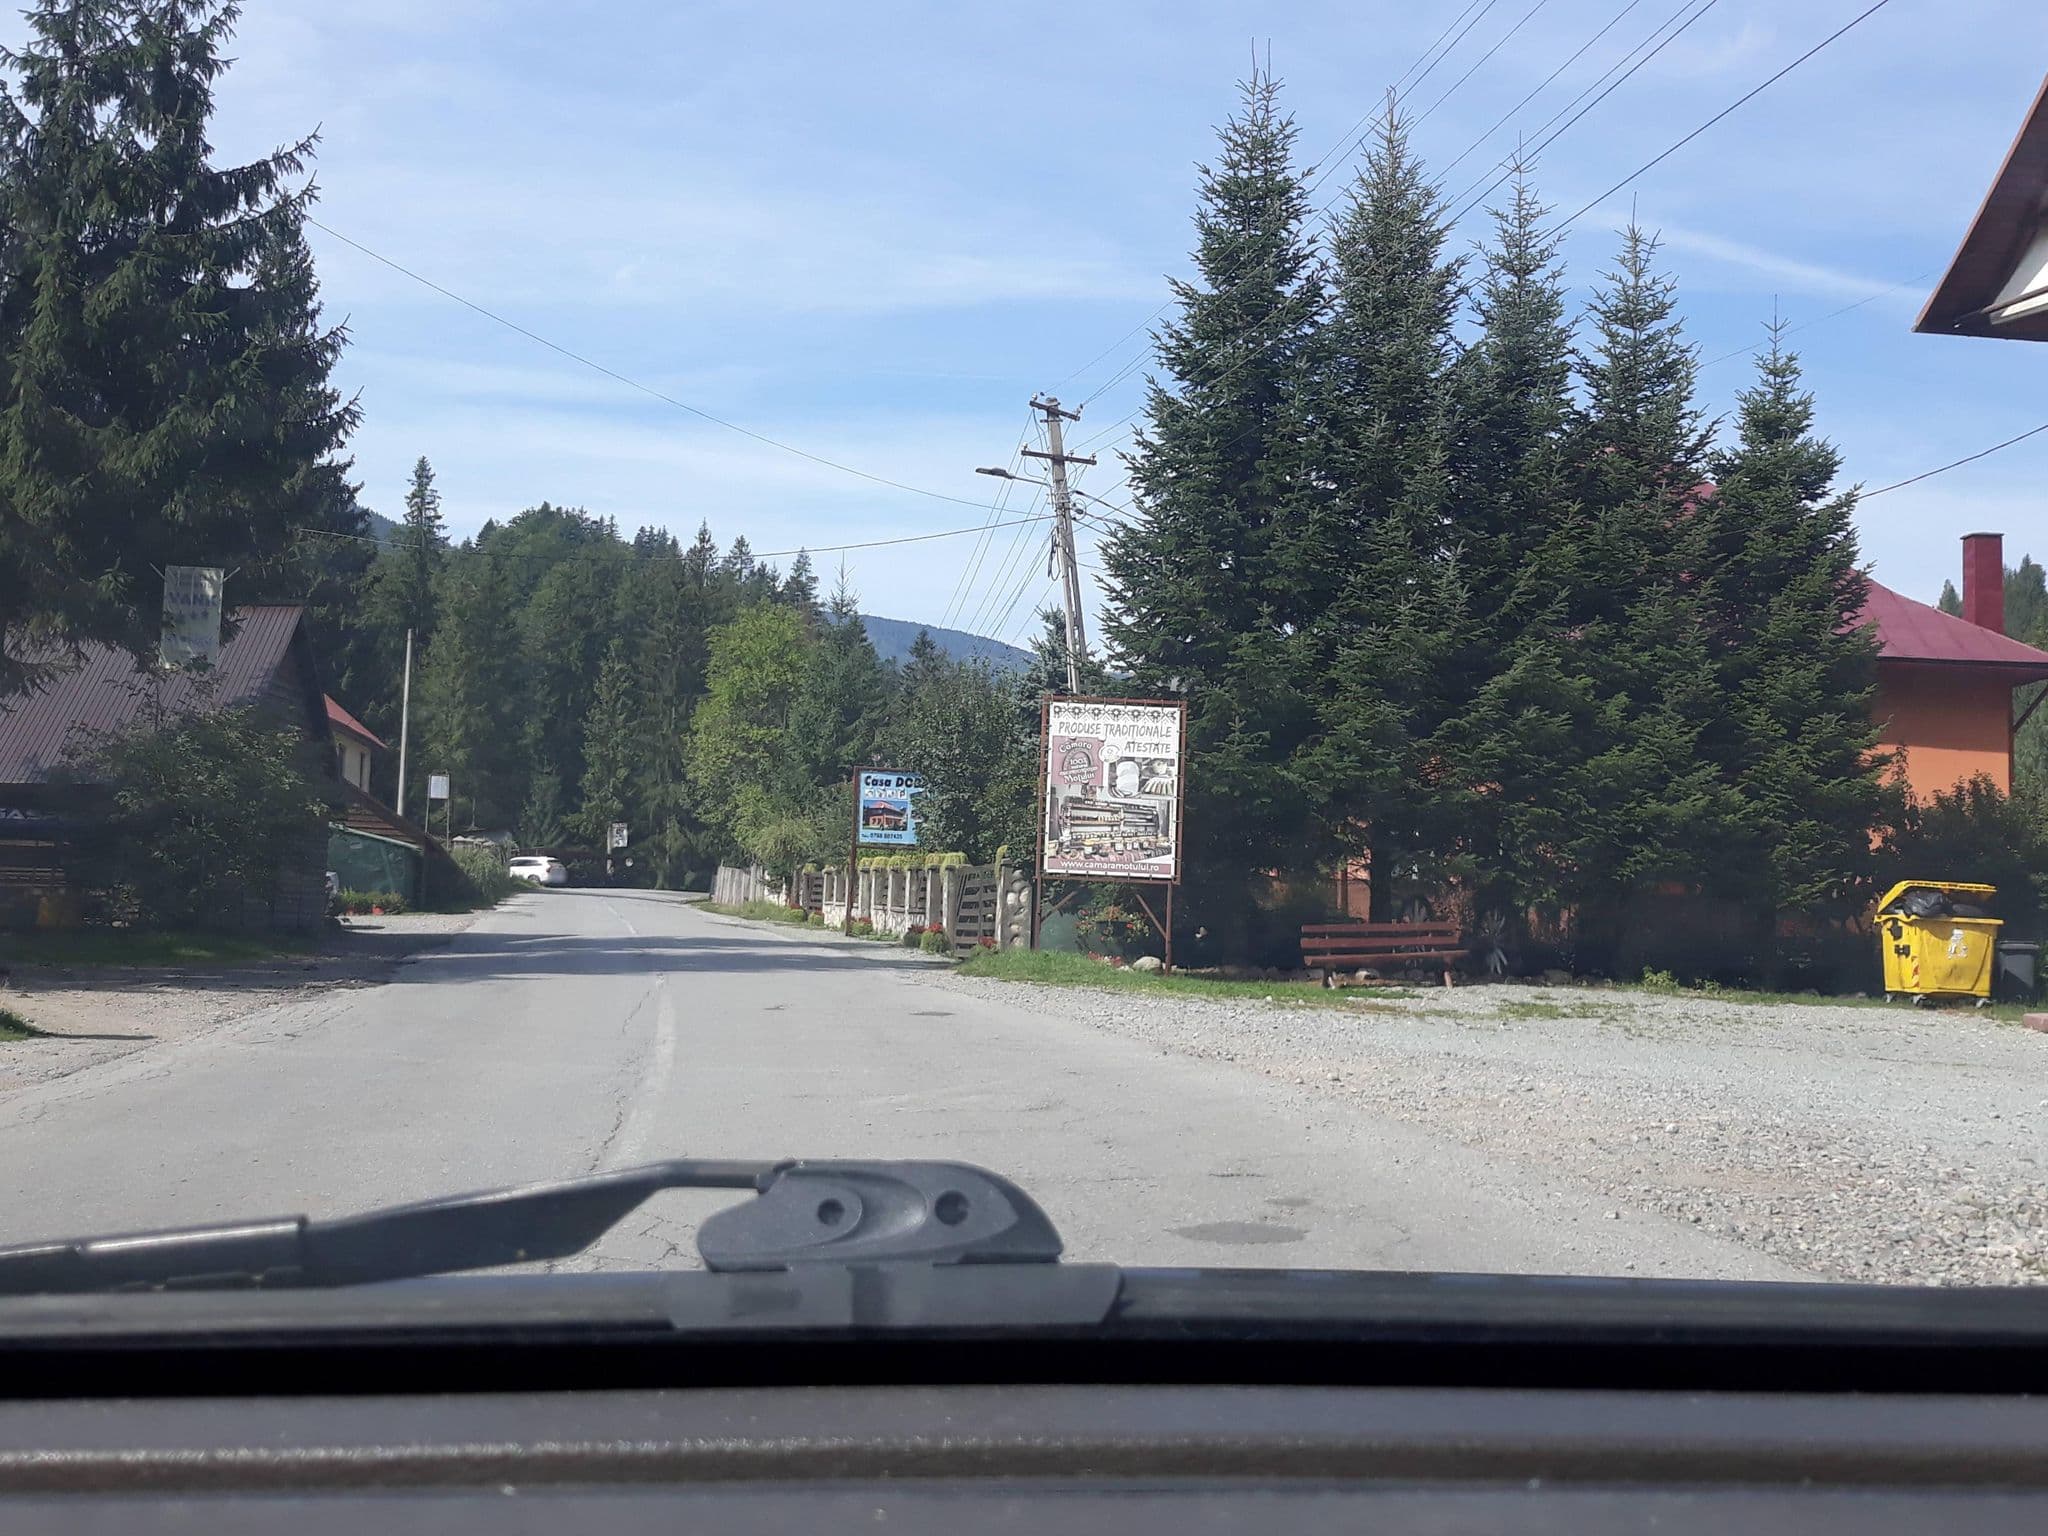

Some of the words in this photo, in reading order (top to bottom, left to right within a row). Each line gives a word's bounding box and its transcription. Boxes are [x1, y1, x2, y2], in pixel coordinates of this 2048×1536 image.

[1059, 722, 1101, 734] PRODUSE
[1124, 741, 1170, 754] ATESTATE
[865, 775, 892, 787] Casa
[1060, 861, 1160, 872] www.camaramotului.ro
